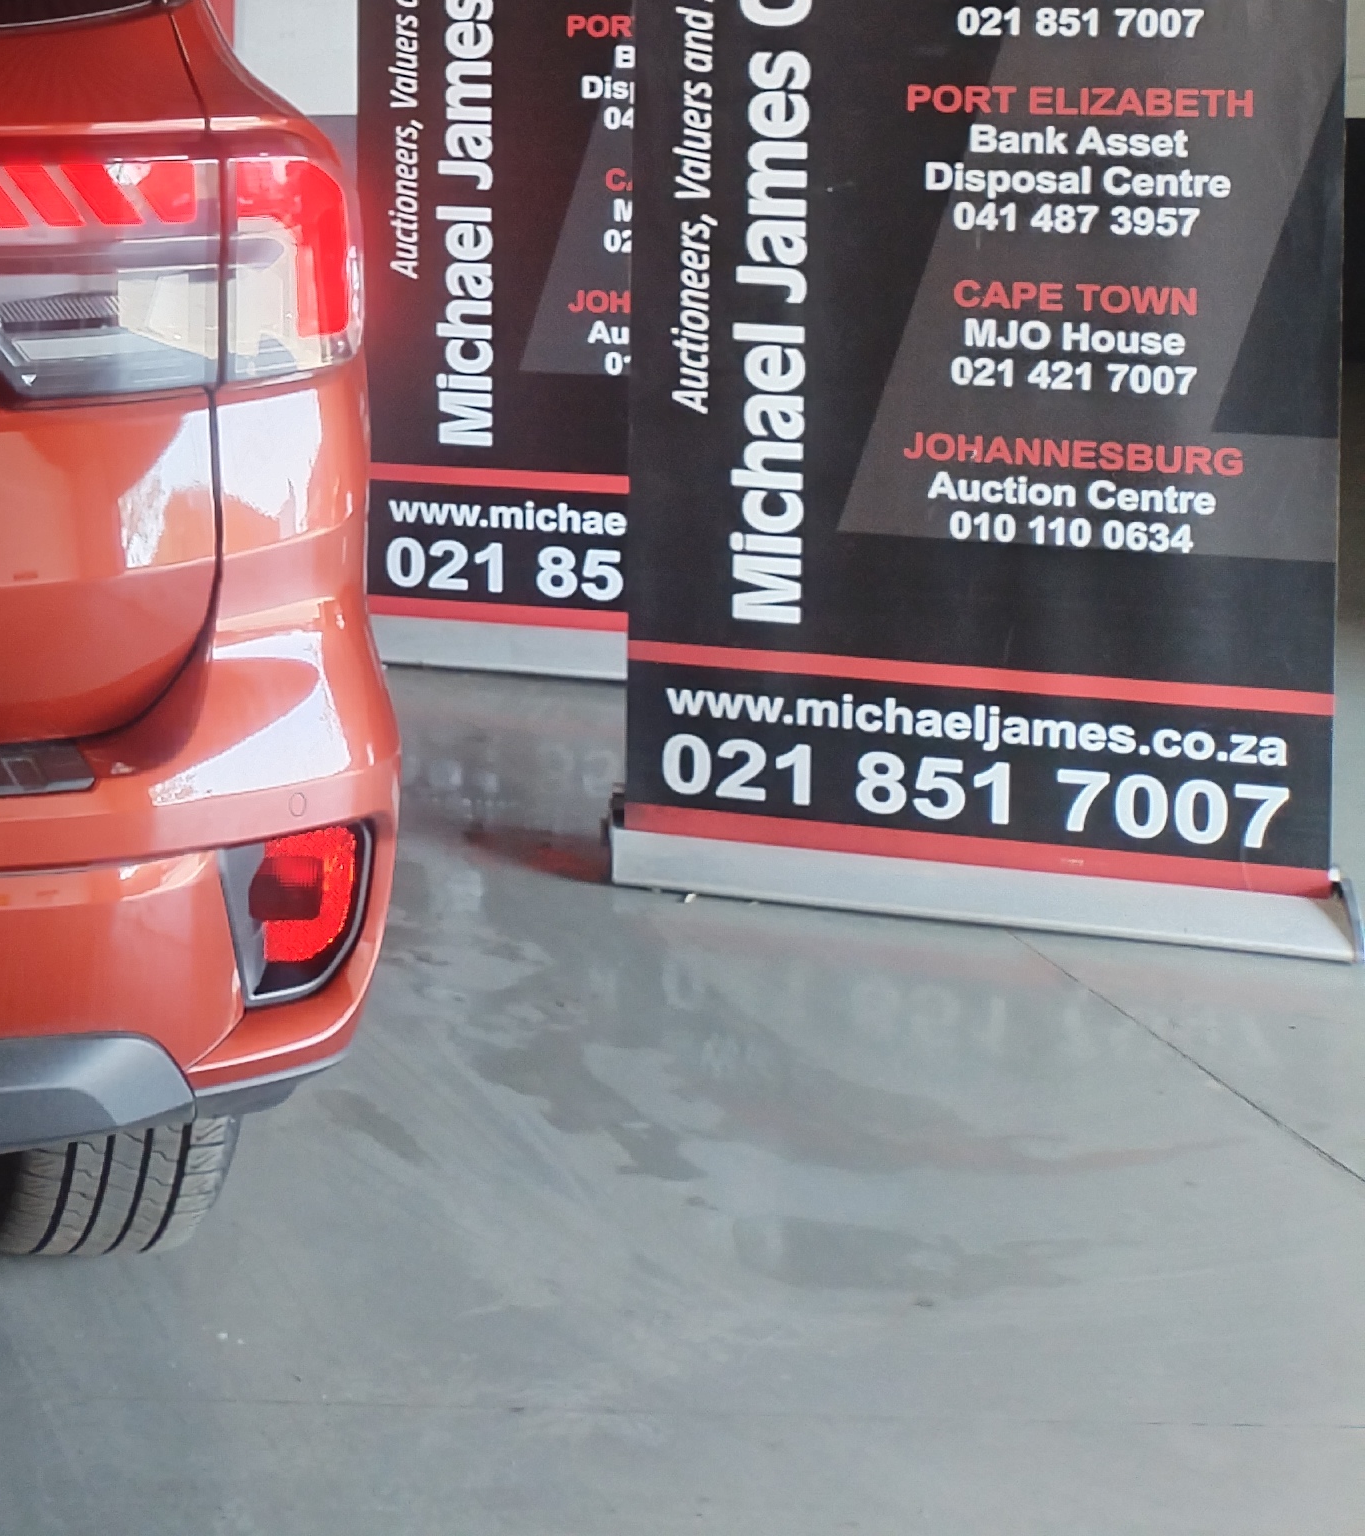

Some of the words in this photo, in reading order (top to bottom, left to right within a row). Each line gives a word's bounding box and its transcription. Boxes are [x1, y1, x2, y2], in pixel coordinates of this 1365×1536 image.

[567, 15, 634, 38] POR
[675, 6, 714, 73] and
[957, 6, 1021, 37] 021
[1035, 7, 1099, 37] 851
[1114, 7, 1205, 38] 7007
[387, 13, 418, 108] Valuers
[907, 84, 1018, 114] PORT
[1029, 86, 1254, 118] ELIZABETH
[672, 80, 713, 199] Valuers
[969, 126, 1067, 153] Bank
[1075, 126, 1189, 158] Asset
[387, 119, 424, 280] Auctioneers,
[735, 50, 811, 304] James
[925, 161, 1092, 200] Disposal
[1102, 165, 1232, 199] Centre
[953, 201, 1017, 232] 041
[1029, 203, 1100, 234] 487
[1109, 205, 1201, 237] 3957
[670, 213, 718, 415] Auctioneers,
[953, 279, 1064, 312] CAPE
[1075, 283, 1198, 317] TOWN
[435, 205, 494, 447] Michael
[964, 320, 1050, 350] MJO
[1062, 321, 1186, 356] House
[950, 356, 1014, 388] 021
[1027, 359, 1092, 391] 421
[1106, 363, 1198, 396] 7007
[729, 322, 806, 625] Michael
[903, 431, 1244, 477] JOHANNESBURG
[927, 471, 1077, 508] Auction
[1087, 479, 1217, 516] Centre
[949, 510, 1016, 543] 010
[1028, 515, 1092, 548] 110
[1102, 519, 1194, 554] 0634
[386, 537, 503, 593] 021
[536, 546, 624, 601] 85
[666, 687, 1288, 767] www.michaeljames.co.za
[662, 733, 812, 806] 021
[855, 751, 1011, 825] 851
[1056, 768, 1290, 849] 7007
